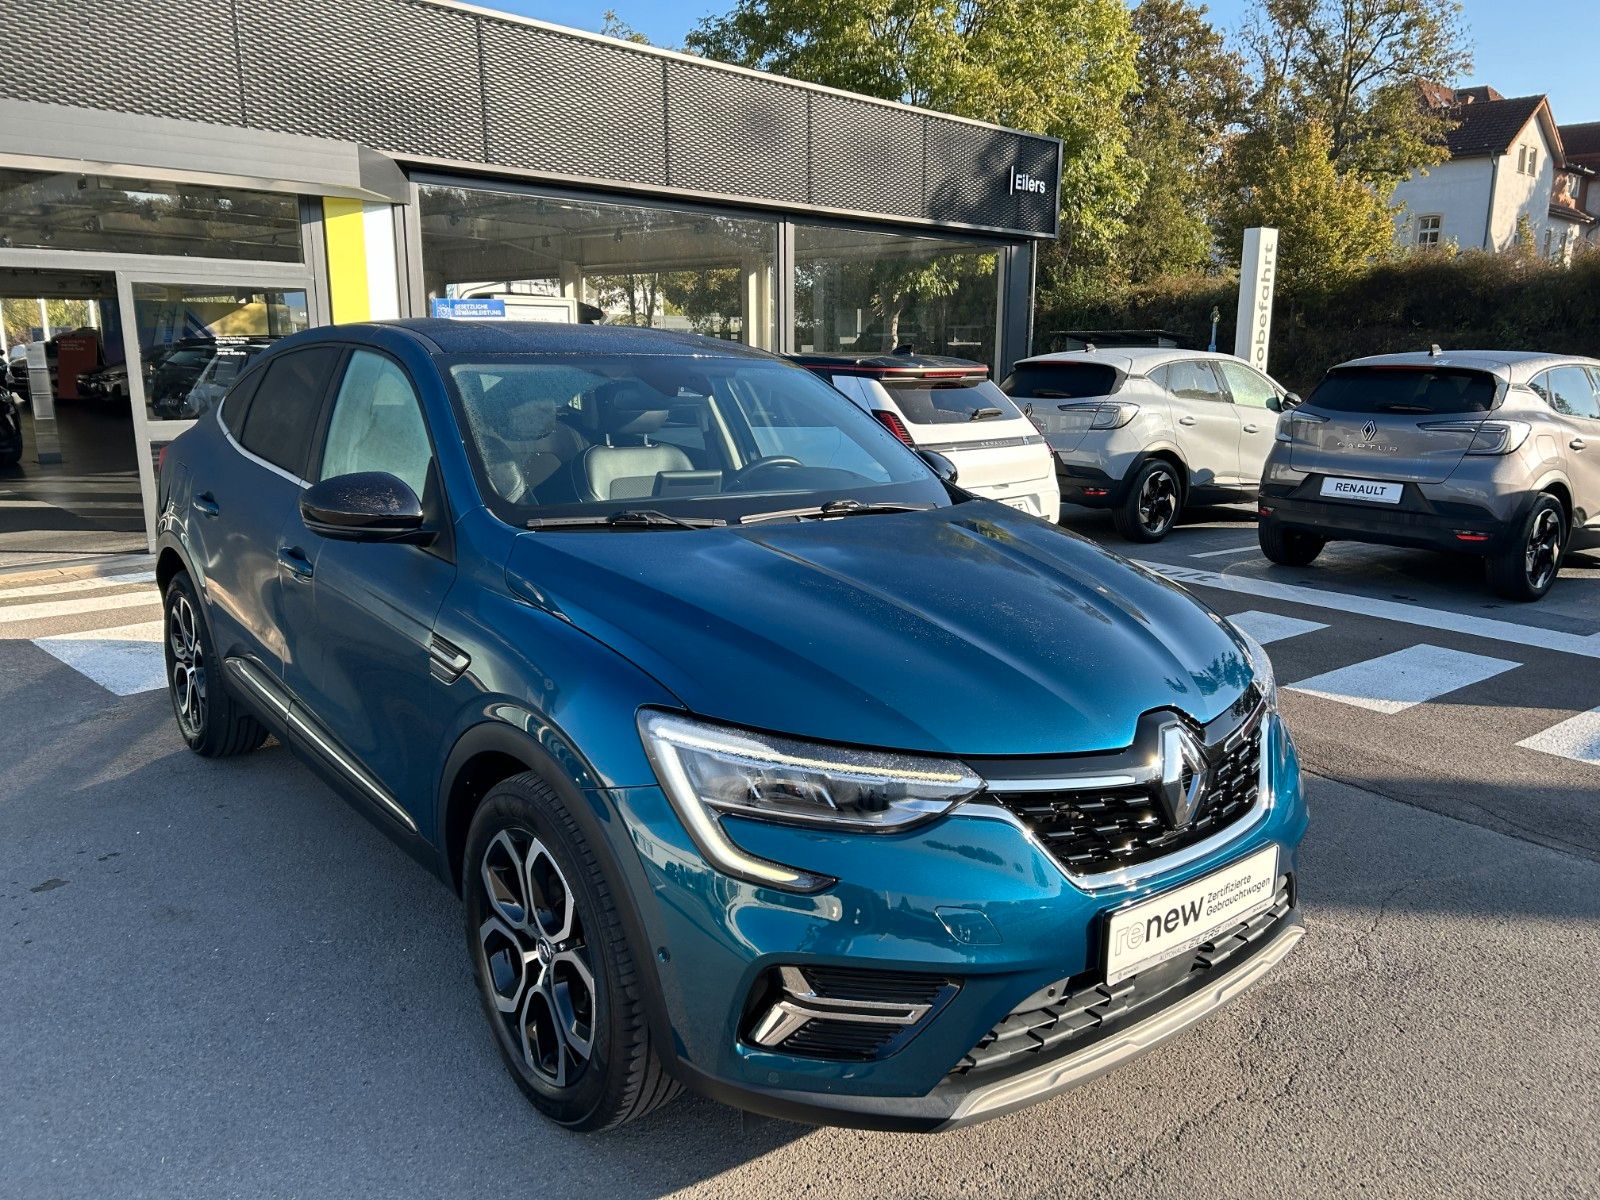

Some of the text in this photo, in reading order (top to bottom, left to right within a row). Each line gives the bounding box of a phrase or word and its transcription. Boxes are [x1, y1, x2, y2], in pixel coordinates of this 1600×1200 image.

[1015, 173, 1046, 193] Eilers
[1335, 482, 1387, 496] RENAULT
[1206, 877, 1271, 916] Gebrauchtwagen
[1207, 875, 1251, 904] Zertifizierte
